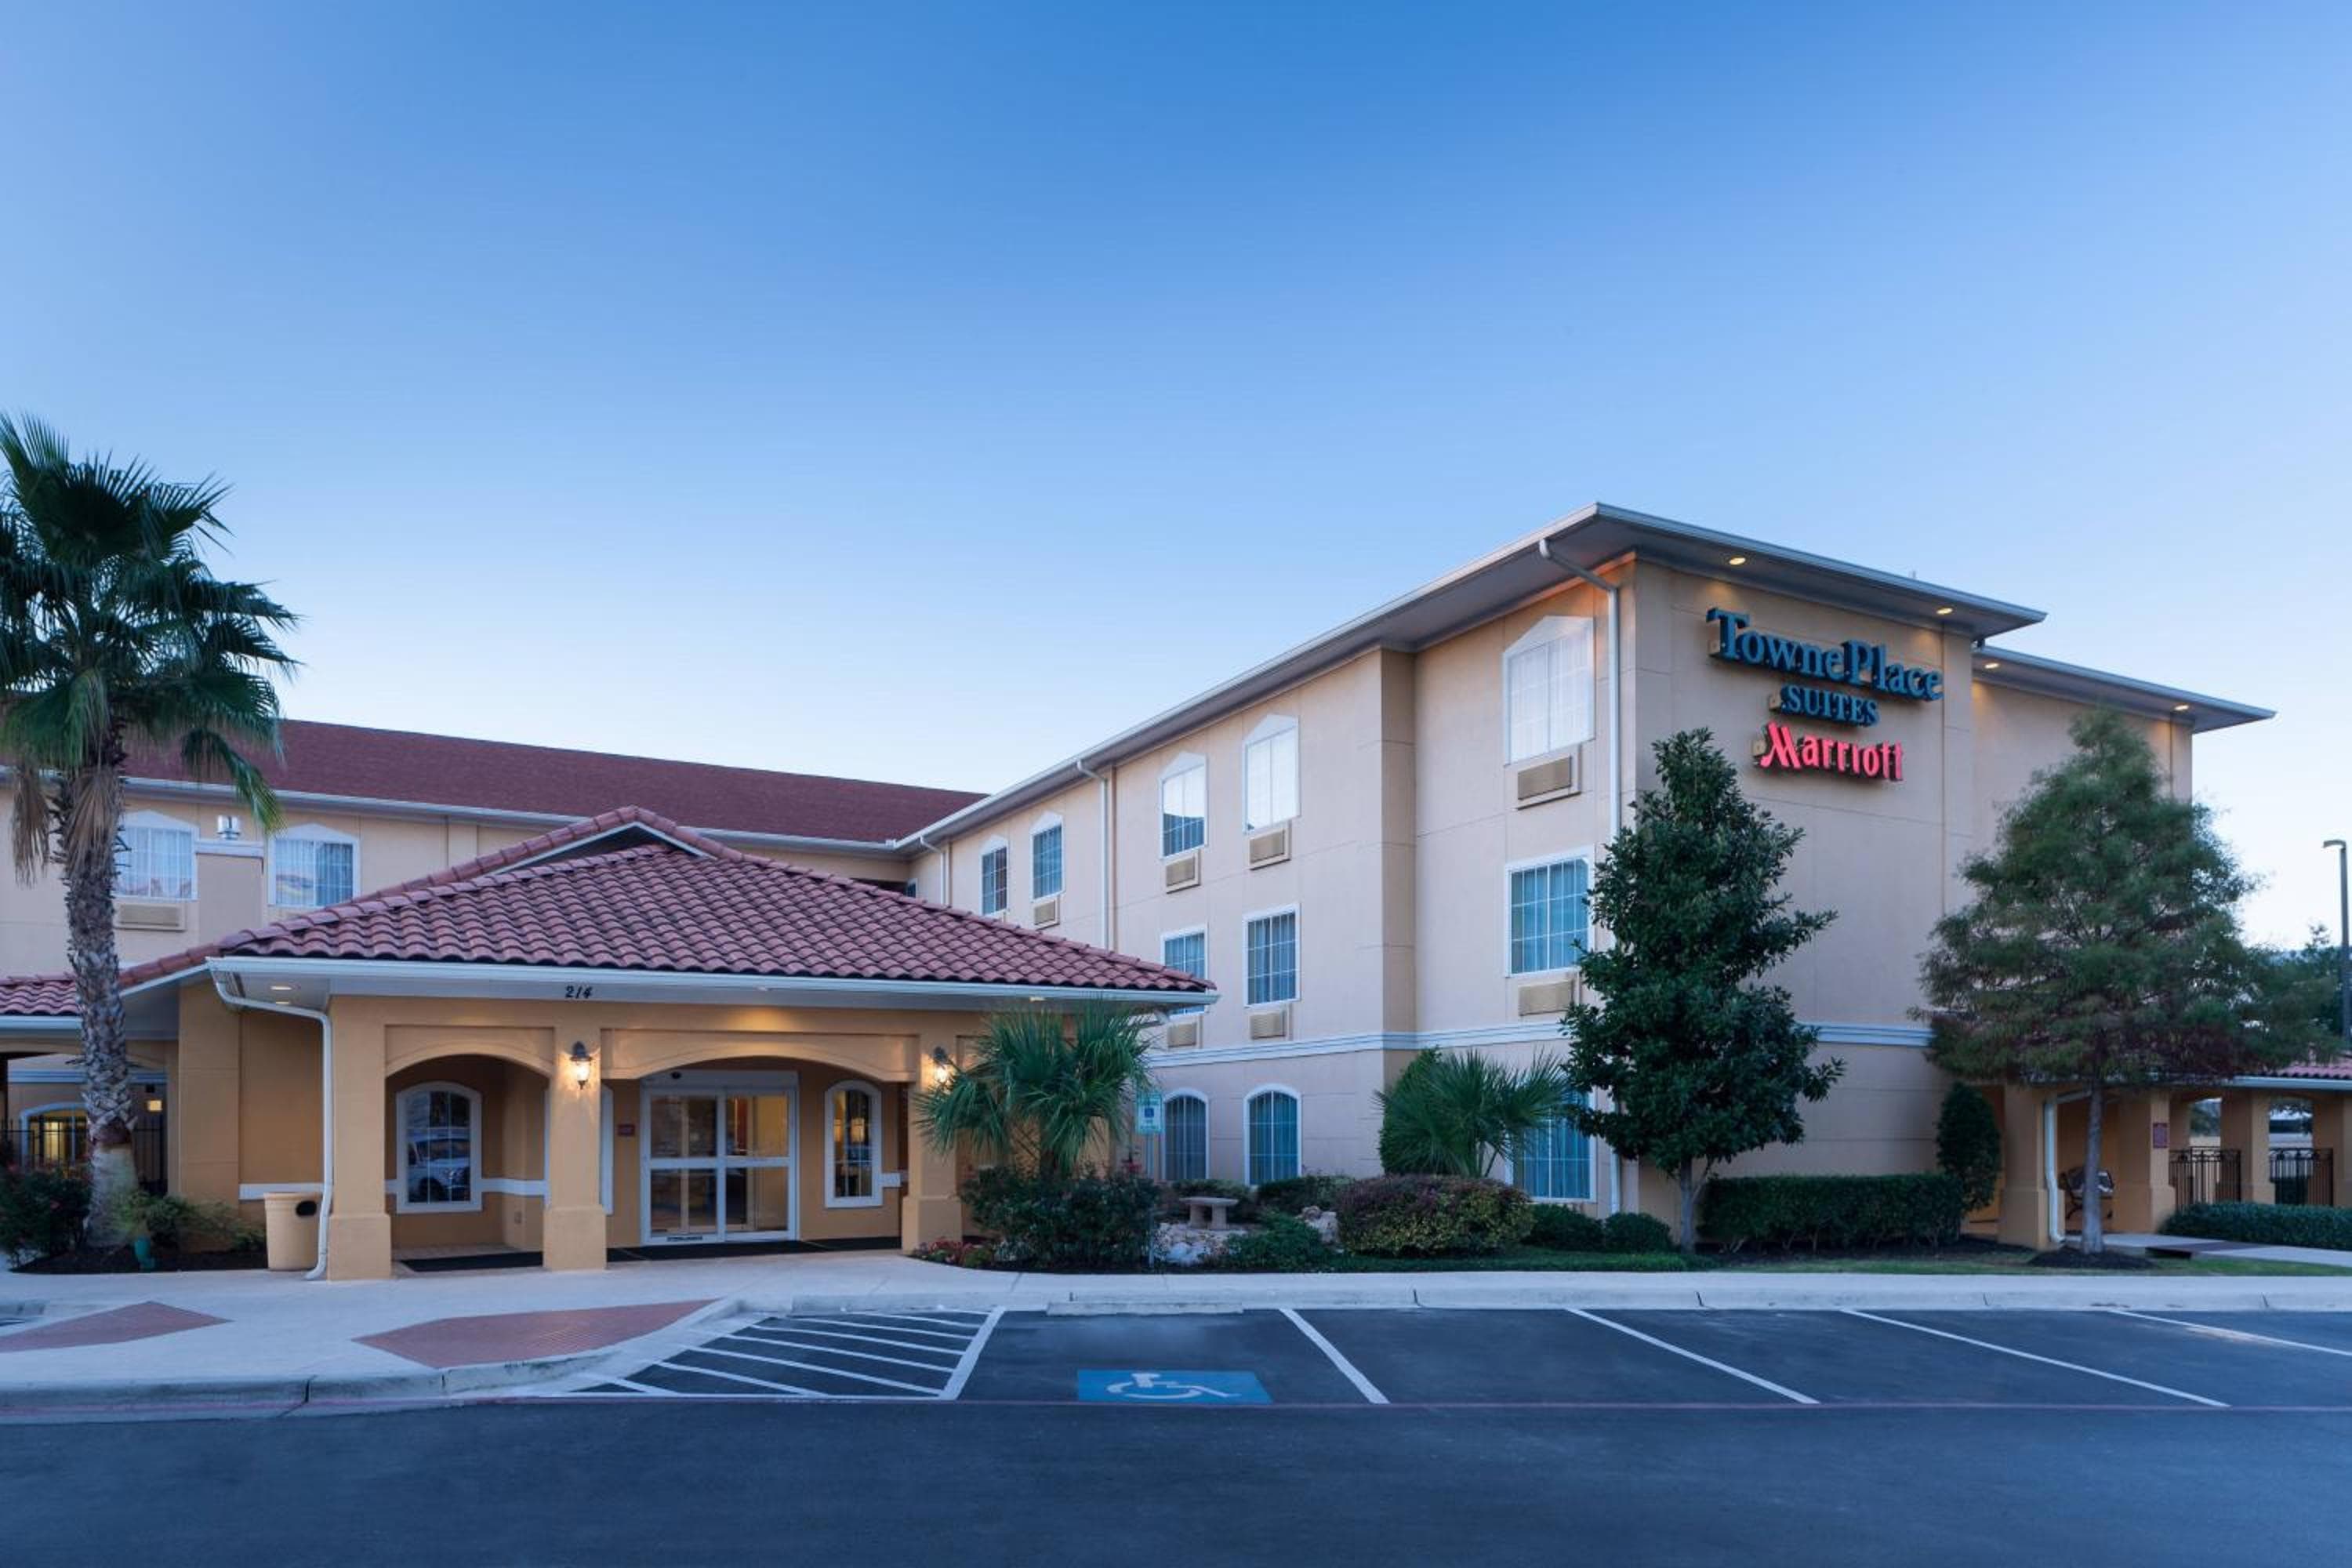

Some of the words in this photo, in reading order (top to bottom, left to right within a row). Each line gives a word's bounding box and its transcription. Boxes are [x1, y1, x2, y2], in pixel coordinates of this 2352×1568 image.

[1706, 607, 1945, 702] TownePlace
[1780, 684, 1880, 728] SUITES
[1758, 721, 1904, 782] Marriott
[564, 985, 593, 1000] 214
